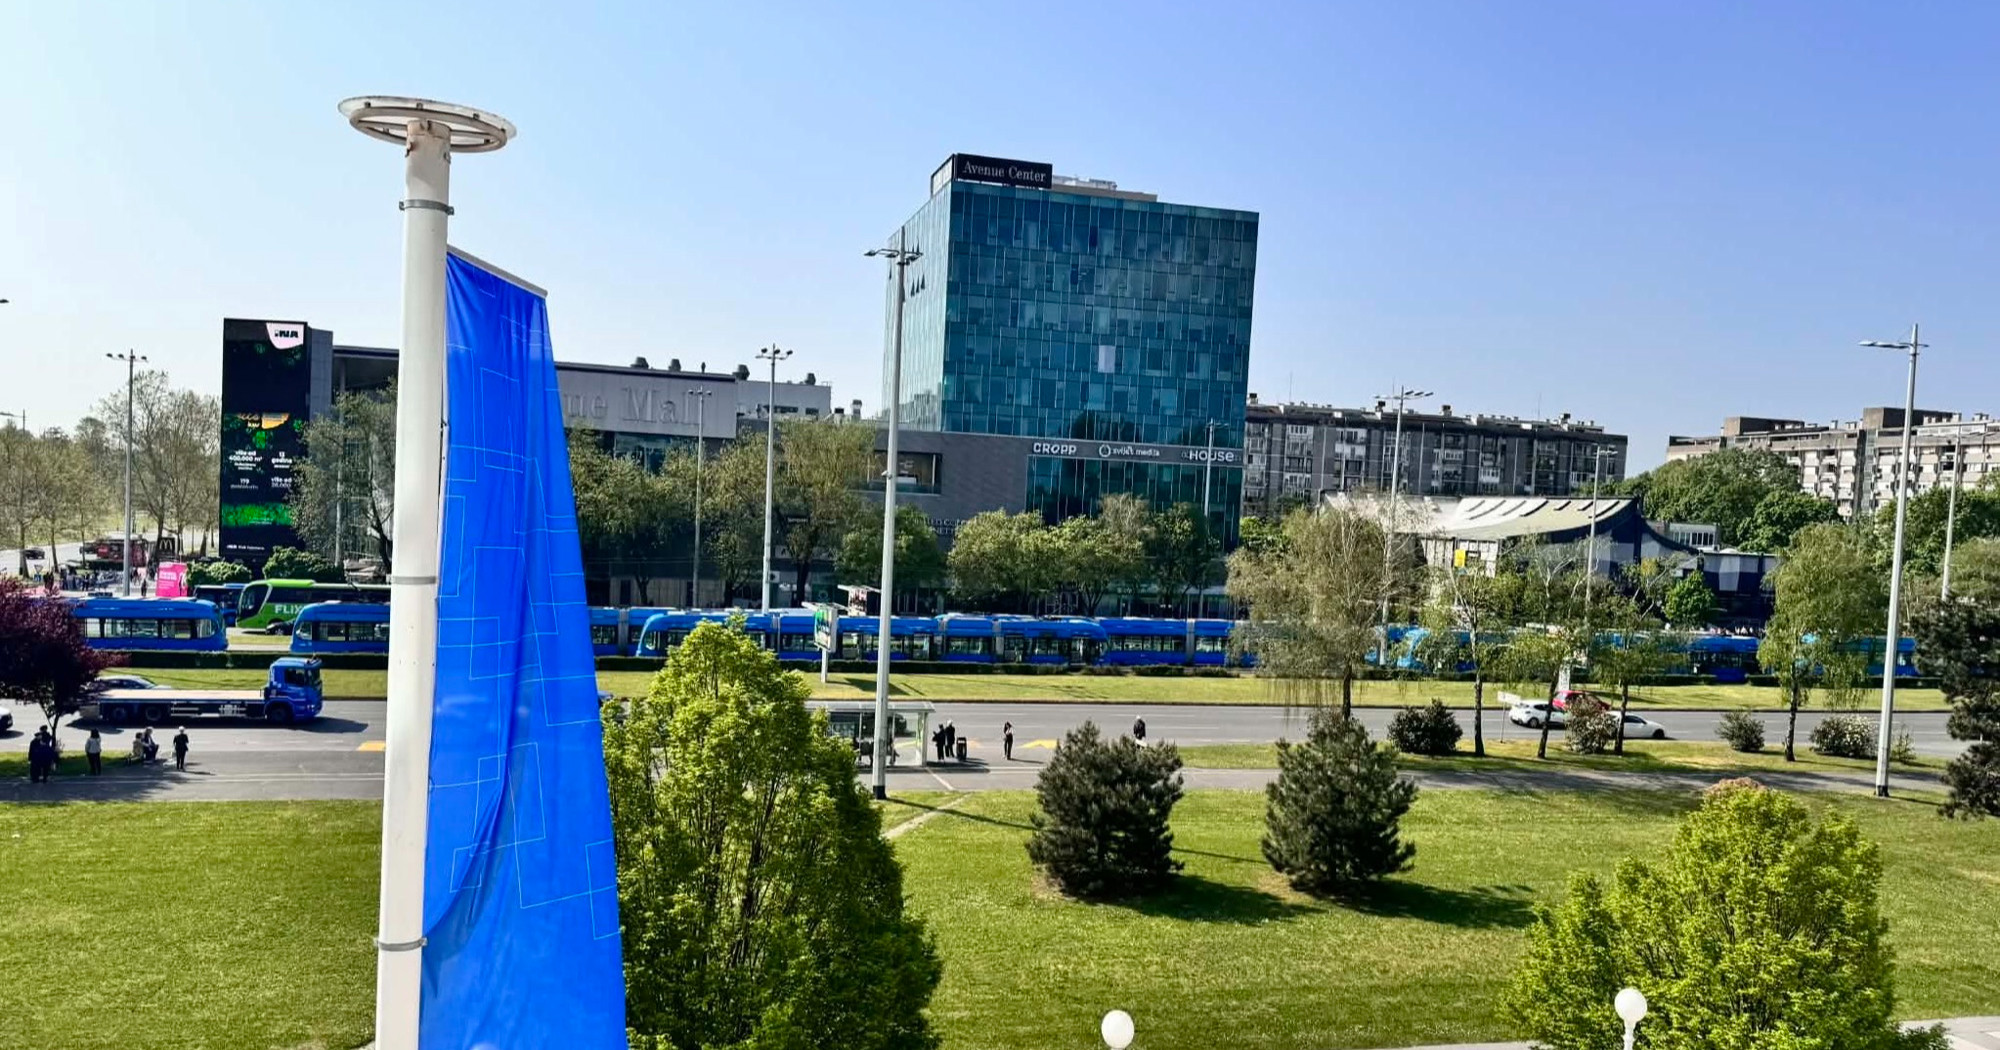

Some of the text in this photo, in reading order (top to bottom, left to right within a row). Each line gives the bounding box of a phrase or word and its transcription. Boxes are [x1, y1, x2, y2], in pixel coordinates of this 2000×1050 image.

[962, 161, 1047, 182] Avenue Center
[1033, 442, 1077, 455] CROPP
[1135, 448, 1160, 457] media
